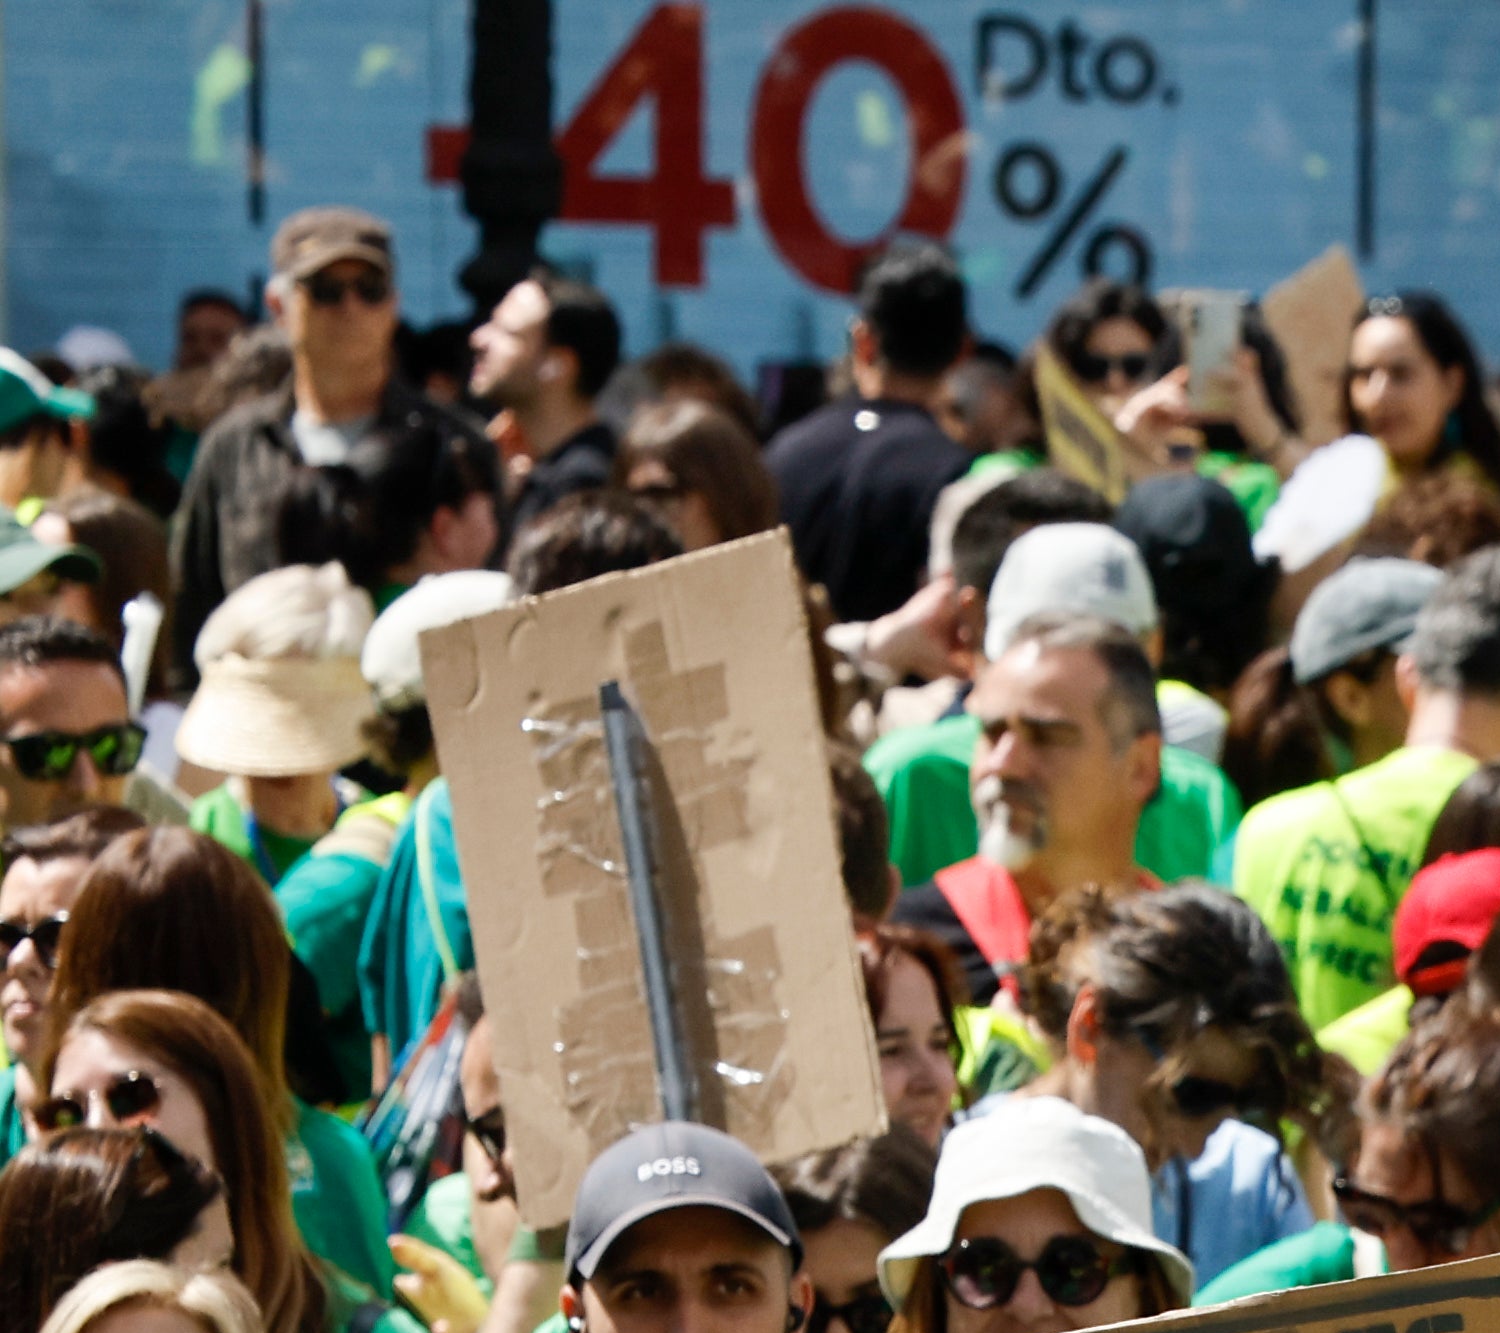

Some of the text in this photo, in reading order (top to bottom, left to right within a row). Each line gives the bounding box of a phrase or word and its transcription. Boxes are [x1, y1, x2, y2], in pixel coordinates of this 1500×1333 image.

[977, 15, 1182, 107] Dto.
[996, 142, 1150, 299] %
[637, 1156, 701, 1182] BOSS
